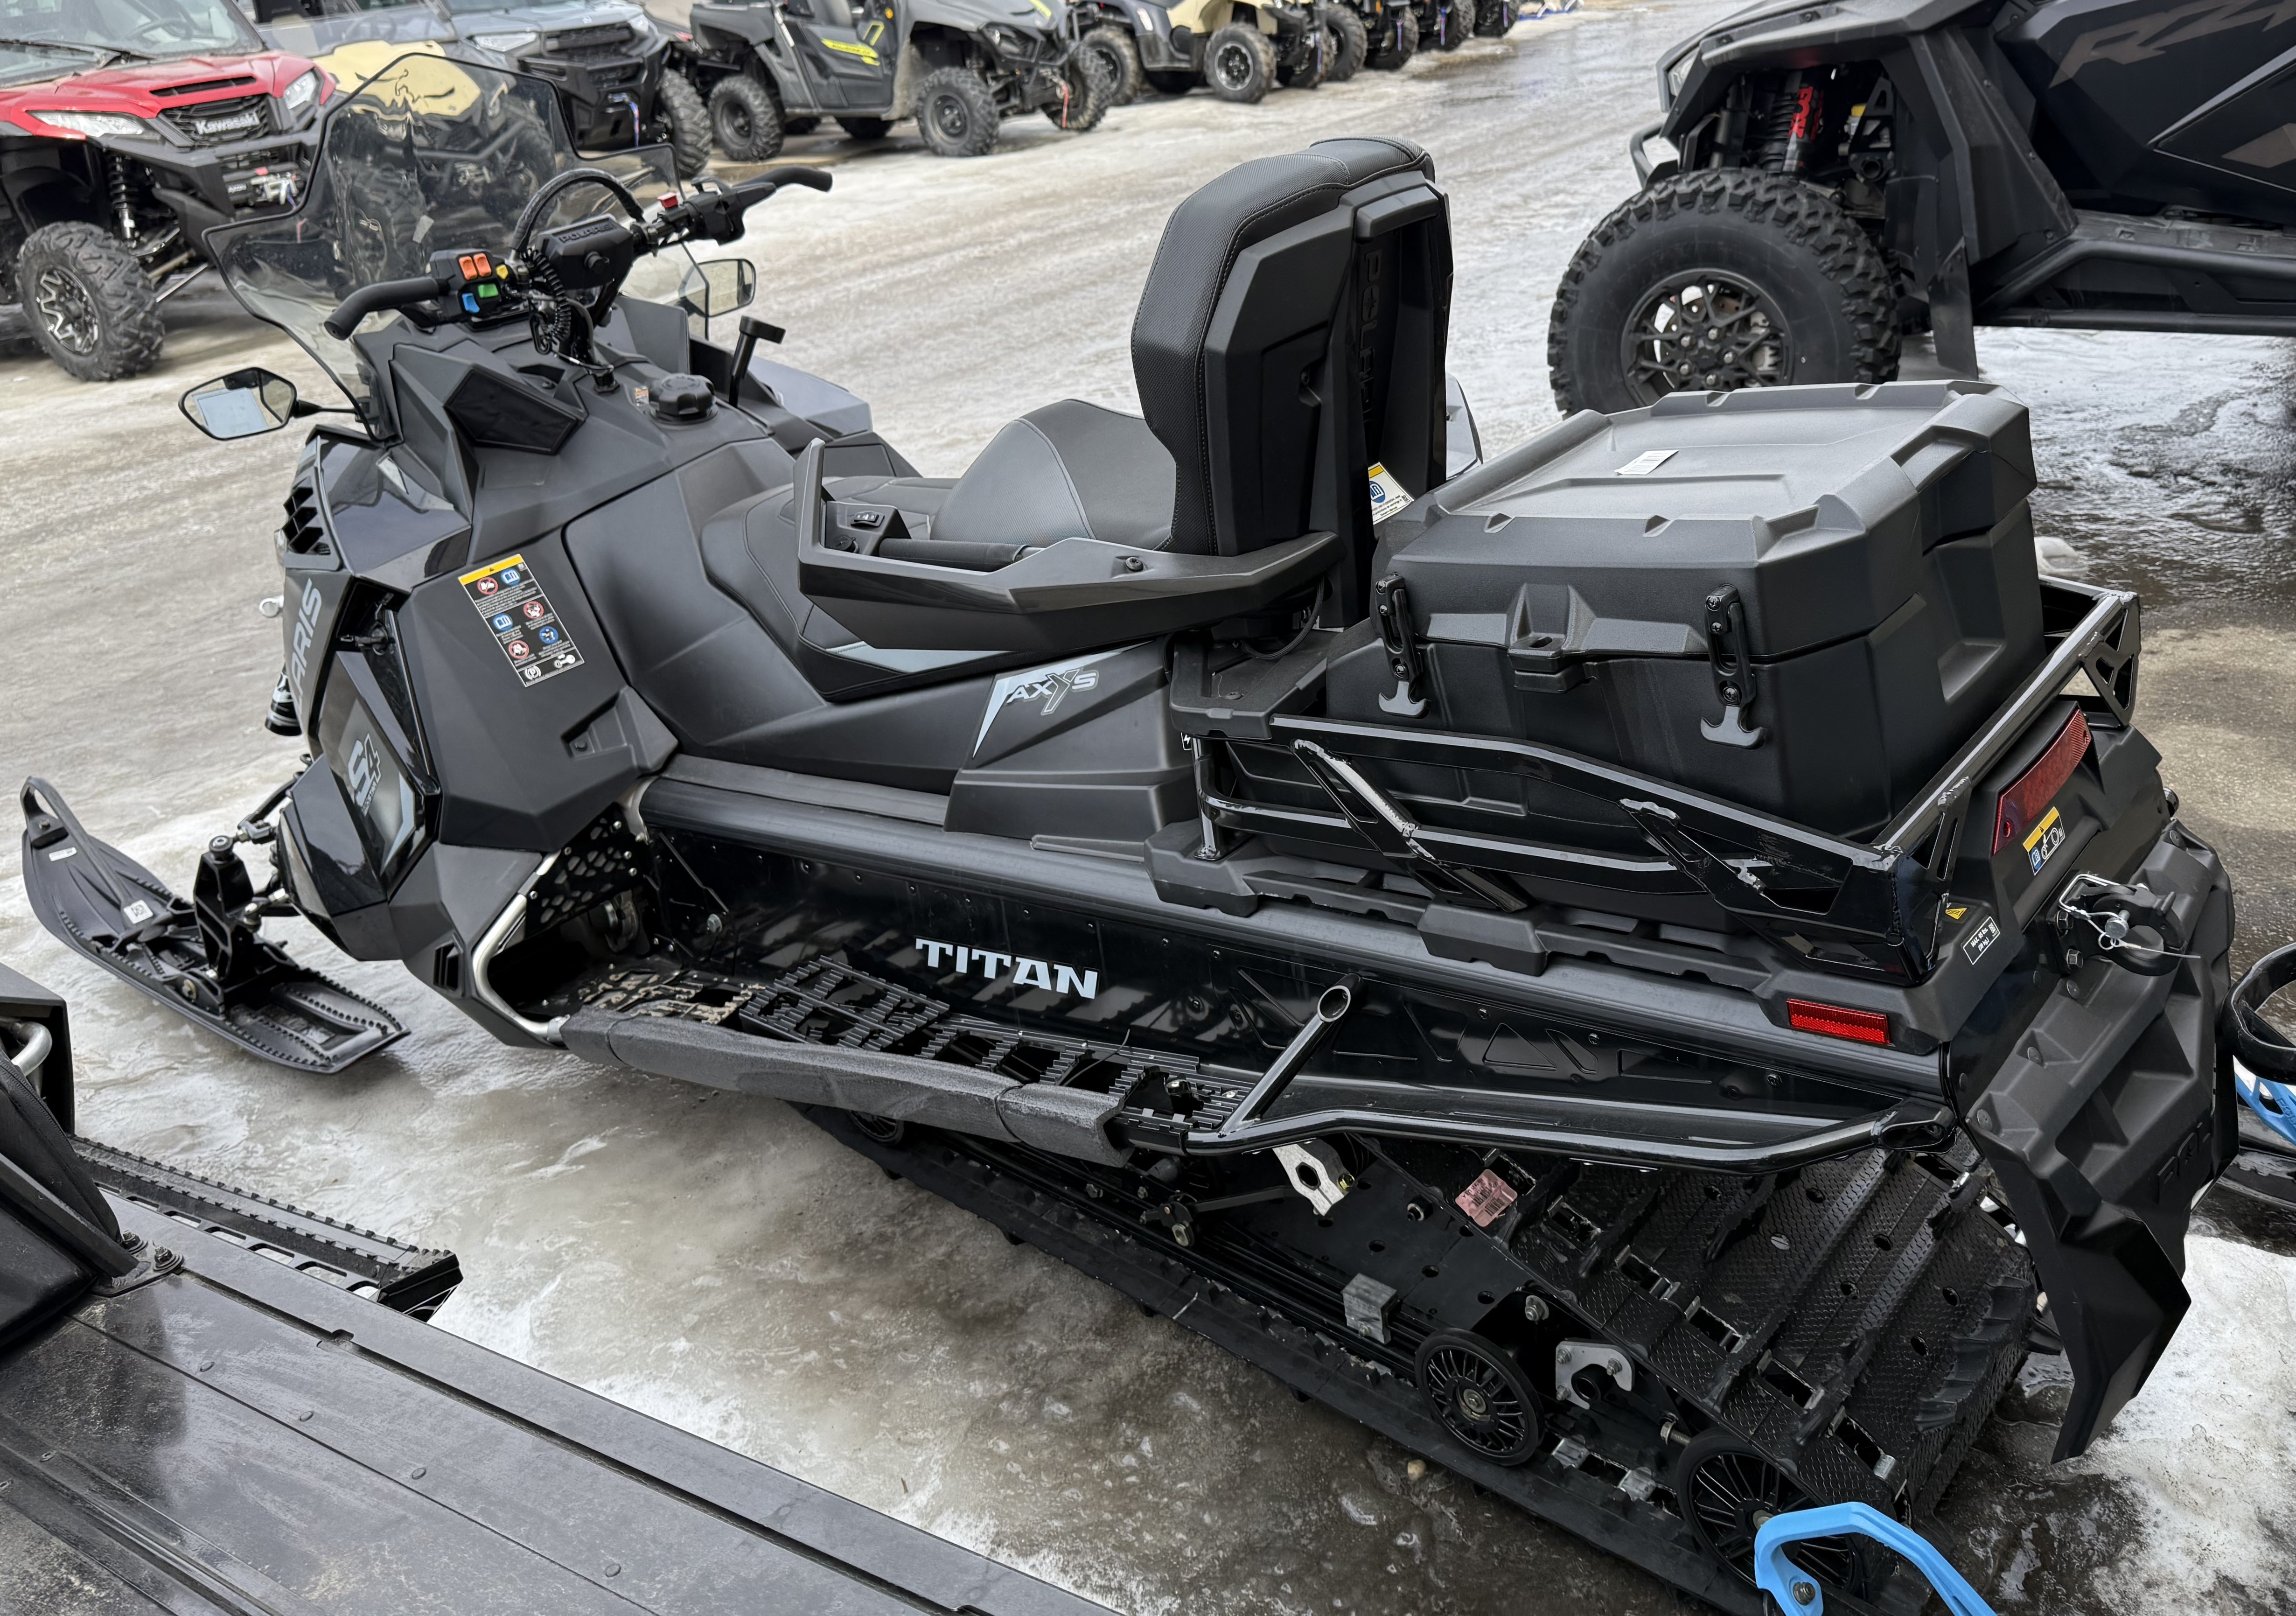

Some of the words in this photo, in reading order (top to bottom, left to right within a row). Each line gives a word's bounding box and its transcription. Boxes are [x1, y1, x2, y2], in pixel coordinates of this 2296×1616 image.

[195, 112, 260, 135] Kawasaki
[559, 224, 614, 243] POLARIS
[1006, 669, 1096, 713] AXYS
[348, 733, 381, 807] S4
[915, 938, 1098, 999] TITAN
